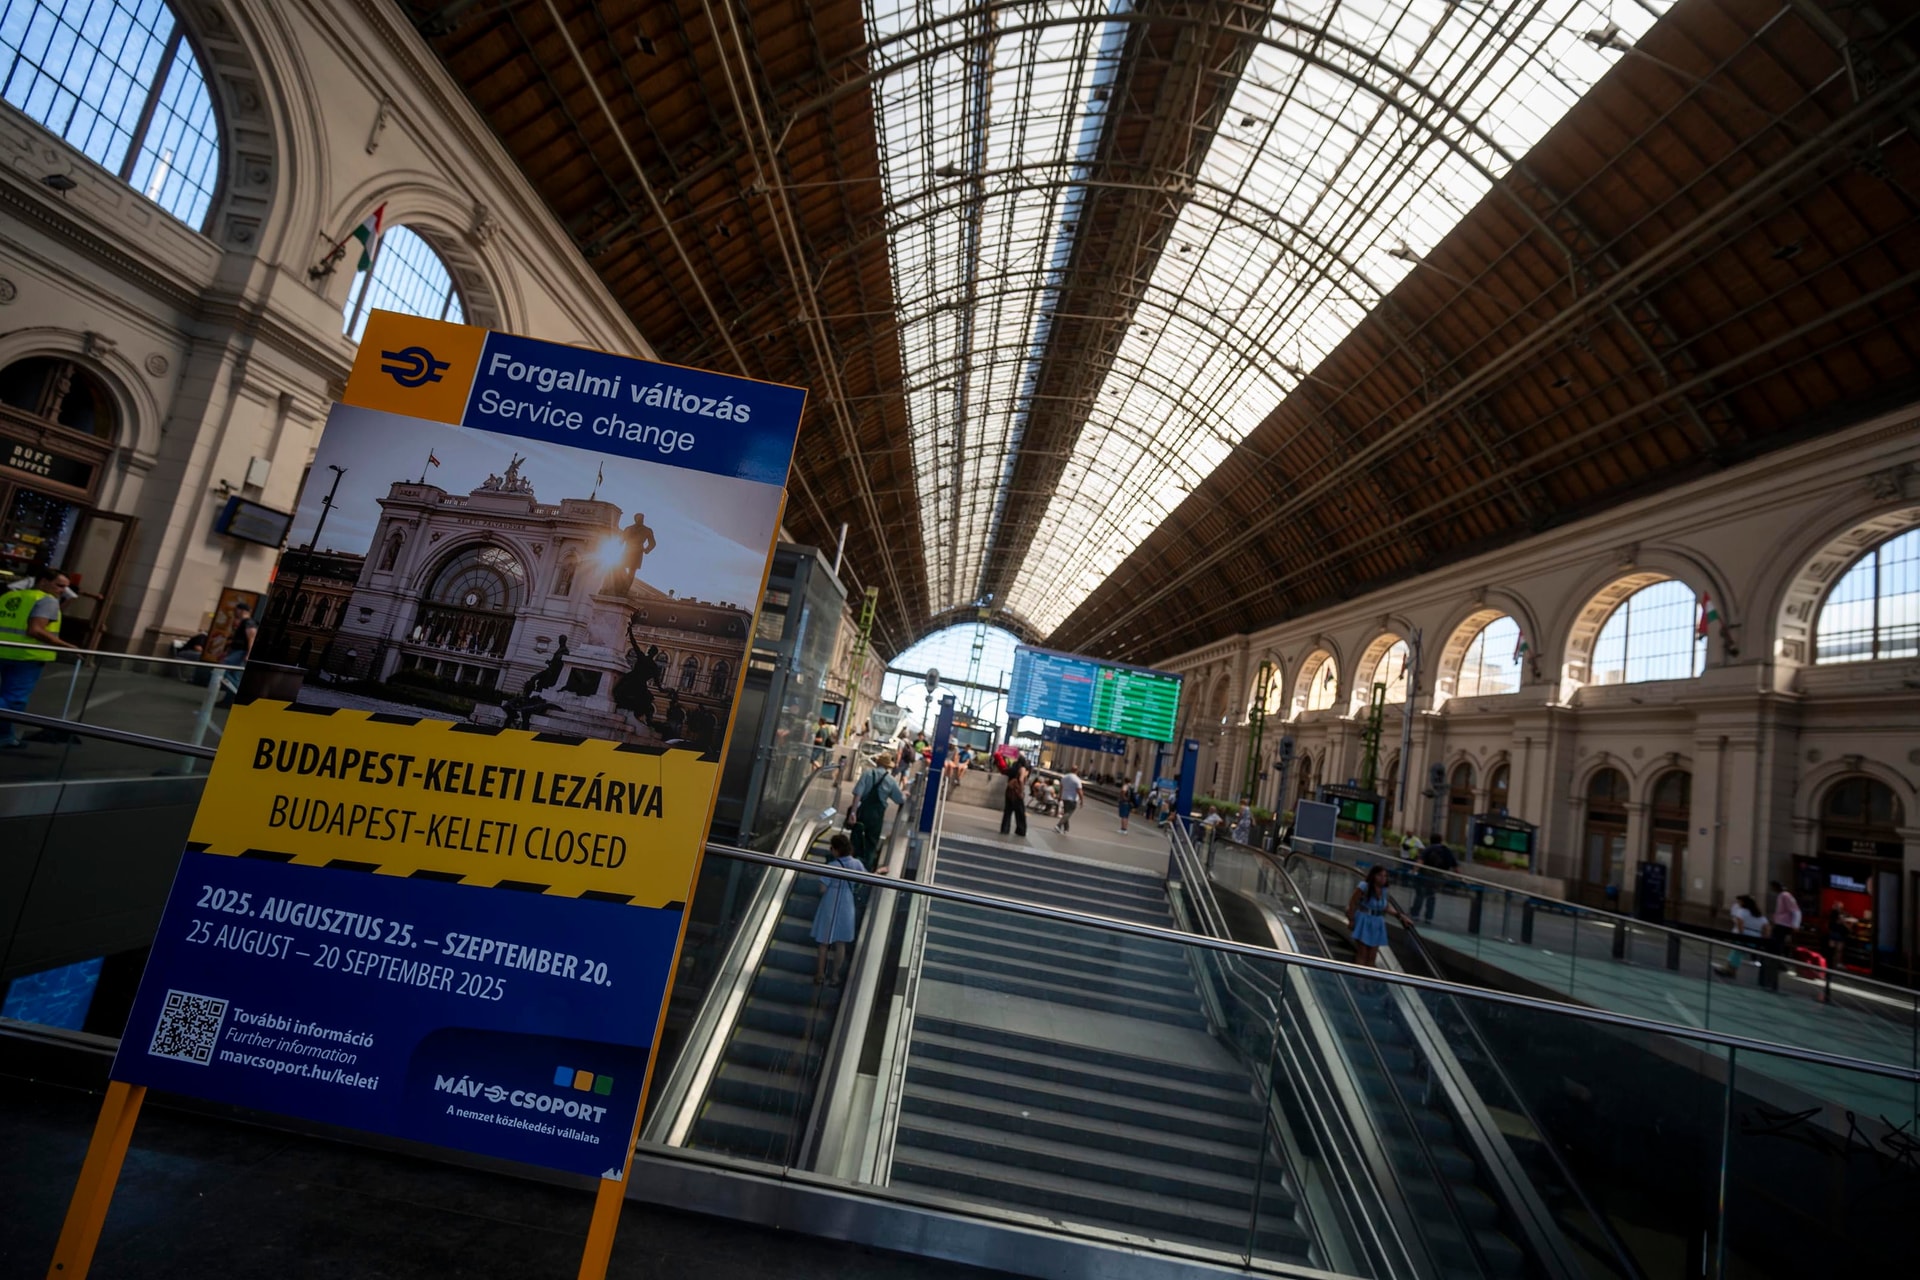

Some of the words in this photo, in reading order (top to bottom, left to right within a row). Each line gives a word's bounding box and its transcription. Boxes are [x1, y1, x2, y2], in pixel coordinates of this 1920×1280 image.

[489, 353, 621, 398] Forgalmi
[631, 383, 750, 422] változás
[479, 390, 582, 430] Service
[593, 414, 694, 453] change
[9, 457, 50, 475] BUFFET
[253, 738, 525, 800] BUDAPEST-KELETI
[532, 772, 662, 818] LEZÁRVA
[269, 795, 517, 855] BUDAPEST-KELETI
[525, 827, 626, 868] CLOSED
[186, 920, 213, 943] 25
[214, 925, 294, 959] AUGUST
[314, 945, 340, 969] 20
[342, 950, 454, 991] SEPTEMBER
[456, 972, 506, 1000] 2025
[197, 886, 254, 916] 2025.
[260, 897, 384, 940] AUGUSZTUS
[384, 922, 416, 948] 25.
[442, 933, 578, 979] SZEPTEMBER
[580, 960, 611, 987] 20.
[225, 1027, 274, 1048] Further
[276, 1037, 356, 1064] information
[234, 1008, 292, 1031] További
[294, 1020, 373, 1047] információ
[220, 1050, 379, 1090] mavcsoport.hu/keleti
[434, 1075, 484, 1097] MÁV
[510, 1090, 606, 1123] CSOPORT
[446, 1105, 453, 1115] A
[456, 1109, 494, 1123] nemzet
[496, 1114, 555, 1135] közlekedési
[558, 1128, 599, 1144] vállalata
